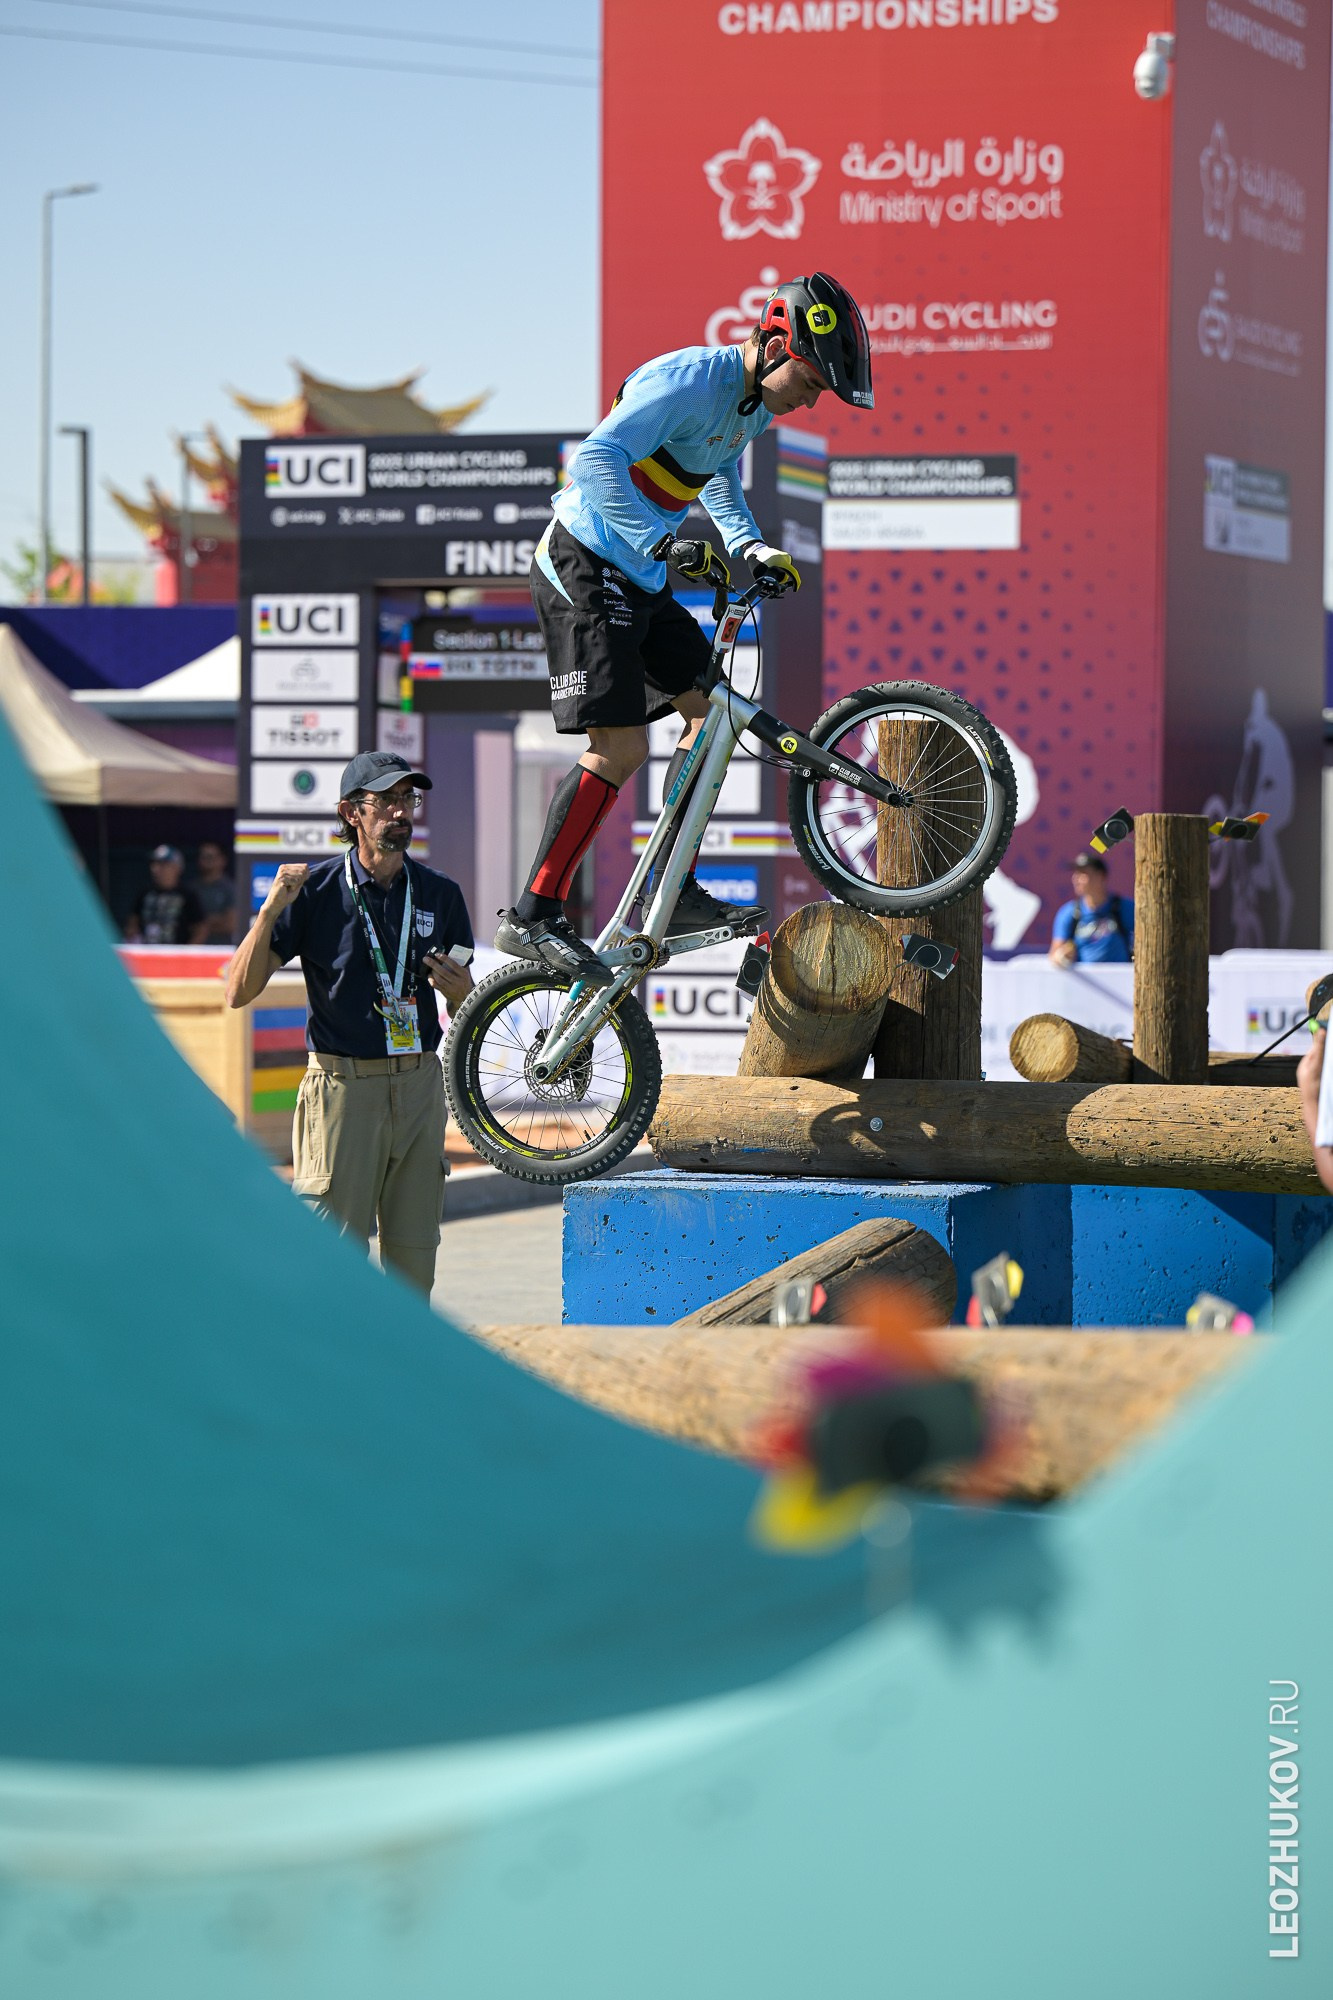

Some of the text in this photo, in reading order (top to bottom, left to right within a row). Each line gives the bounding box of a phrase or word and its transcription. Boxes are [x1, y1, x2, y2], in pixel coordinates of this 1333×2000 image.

[718, 0, 1059, 35] CHAMPIONSHIPS
[841, 136, 1064, 188] وزارة الرياضة
[840, 187, 1063, 229] Ministry of Sport
[861, 299, 1058, 331] UDI CYCLING
[404, 452, 450, 469] URBAN
[453, 450, 527, 469] CYCLING
[866, 460, 916, 478] URBAN
[918, 459, 985, 478] CYCLING
[284, 457, 356, 486] UCI
[368, 467, 556, 488] WORLD CHAMPIONSHIPS
[829, 476, 1014, 496] WORLD CHAMPIONSHIPS
[446, 541, 538, 576] FINIS
[276, 606, 343, 635] UCI
[550, 672, 569, 690] CLUB
[267, 729, 341, 743] TISSOT
[282, 830, 324, 846] UCI
[703, 831, 725, 846] CI
[673, 989, 741, 1016] UCI
[1264, 1010, 1310, 1033] UC
